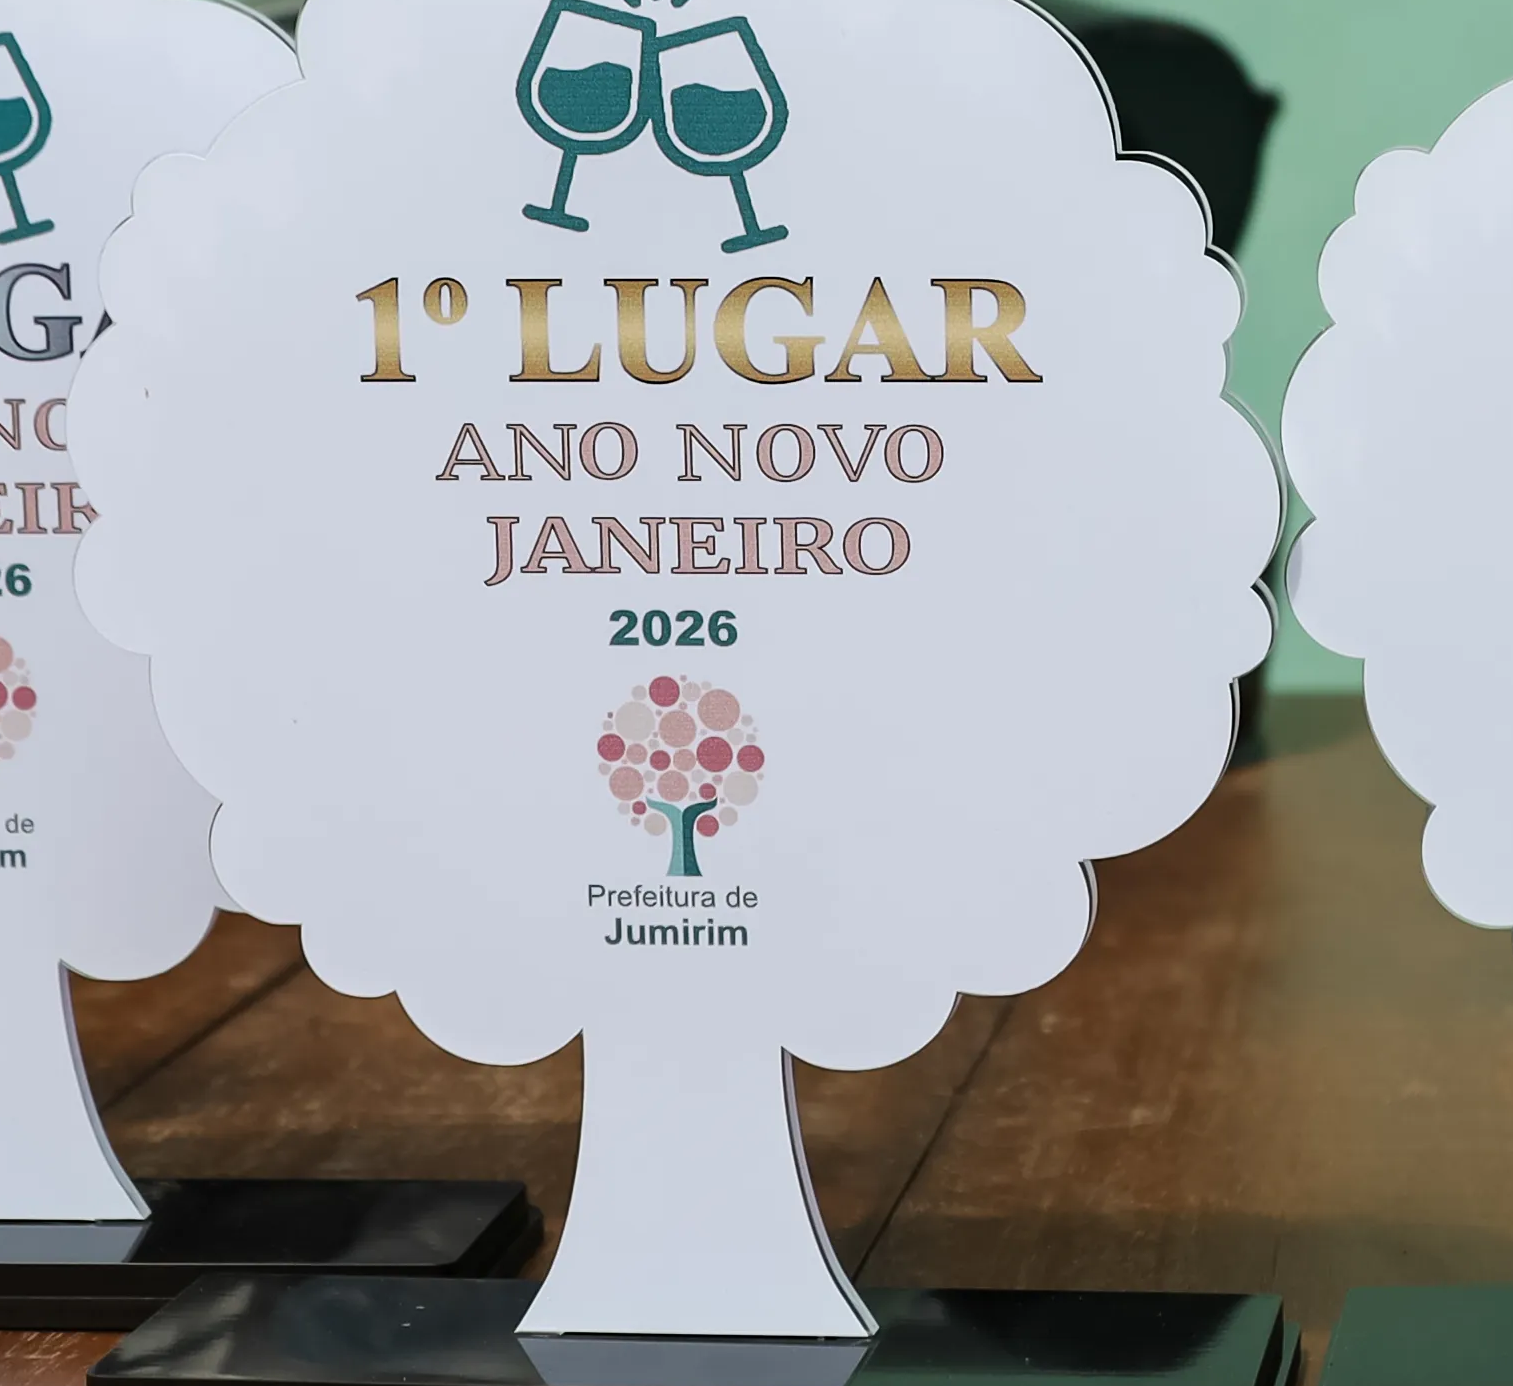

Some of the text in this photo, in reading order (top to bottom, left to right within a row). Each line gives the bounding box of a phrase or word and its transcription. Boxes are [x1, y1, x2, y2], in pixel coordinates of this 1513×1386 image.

[506, 276, 1043, 384] LUGAR
[436, 422, 945, 482] ANO NOVO
[484, 516, 911, 586] JANEIRO
[609, 609, 738, 647] 2026
[5, 813, 34, 833] de
[588, 885, 758, 908] Prefeitura de
[605, 918, 748, 945] Jumirim
